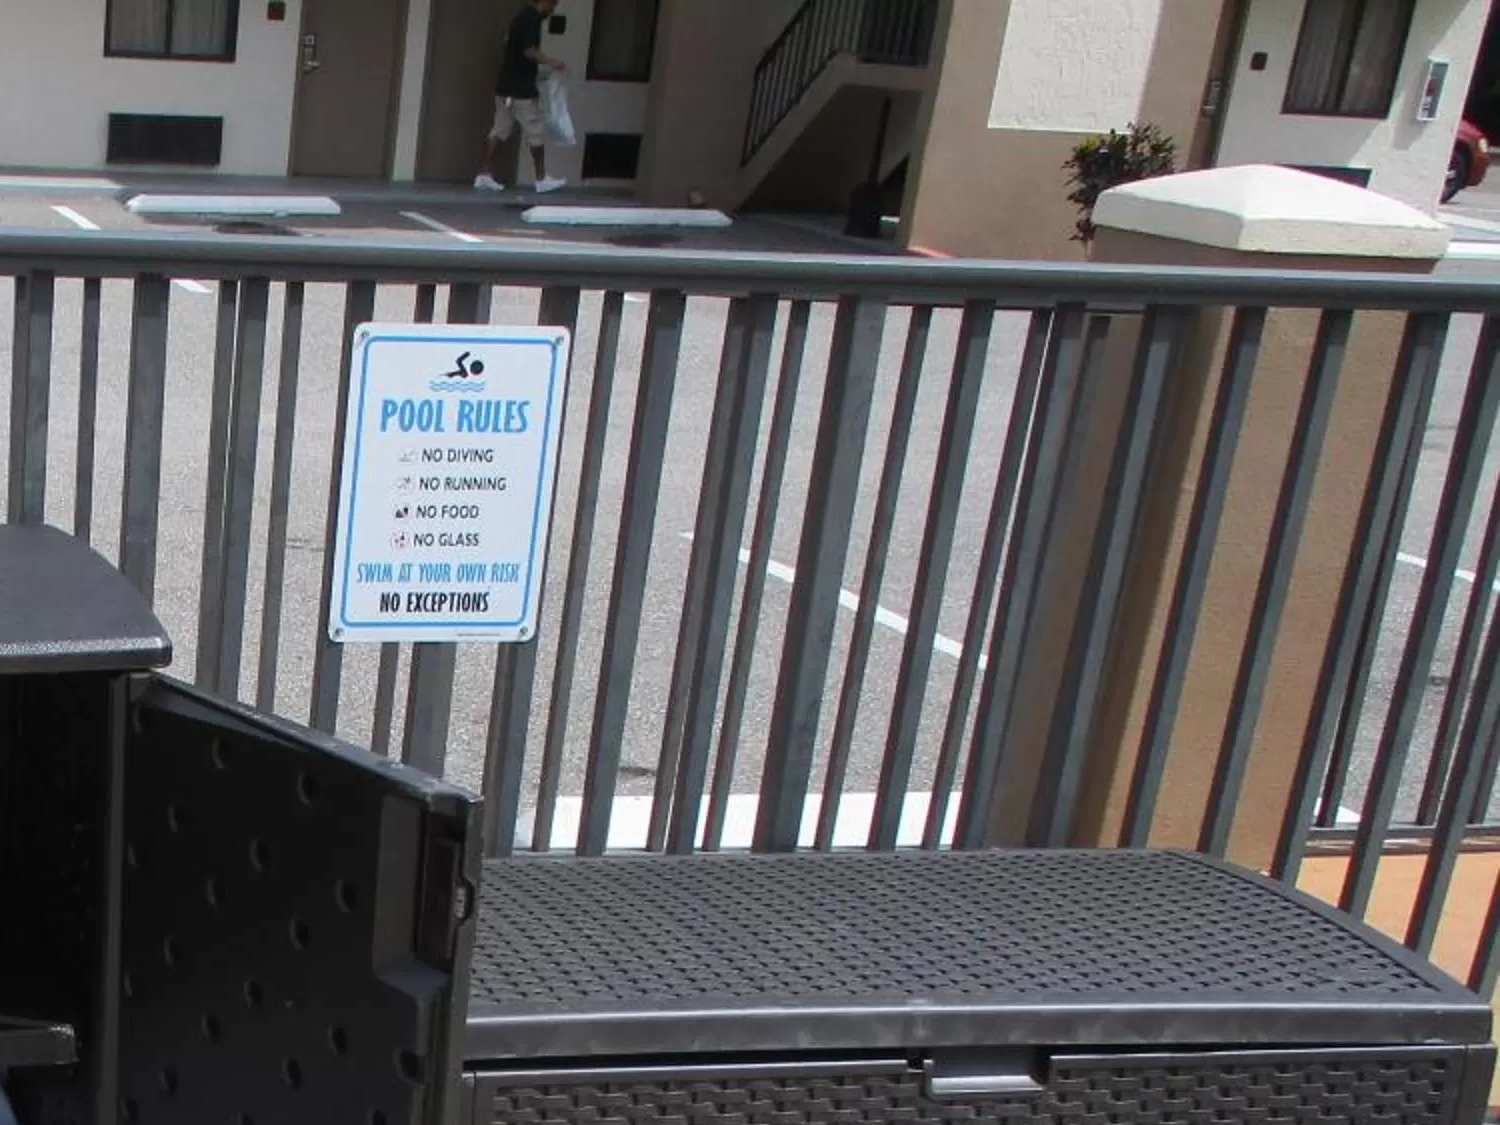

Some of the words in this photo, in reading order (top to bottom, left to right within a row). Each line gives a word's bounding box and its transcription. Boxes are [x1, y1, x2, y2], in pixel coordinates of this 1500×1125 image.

[380, 399, 445, 433] POOL
[456, 400, 530, 433] RULES
[421, 449, 442, 463] NO
[447, 449, 494, 463] DIVING
[419, 477, 440, 490] NO
[444, 477, 506, 491] RUNNING
[416, 505, 437, 518] NO
[441, 505, 479, 518] FOOD
[413, 533, 435, 546] NO
[439, 533, 479, 547] GLASS
[356, 563, 392, 583] SWIM
[399, 564, 415, 581] AT
[419, 564, 451, 582] YOUR
[457, 563, 486, 582] OWN
[490, 563, 521, 583] RISK
[379, 592, 400, 613] NO
[405, 592, 489, 613] EXCEPTIONS
